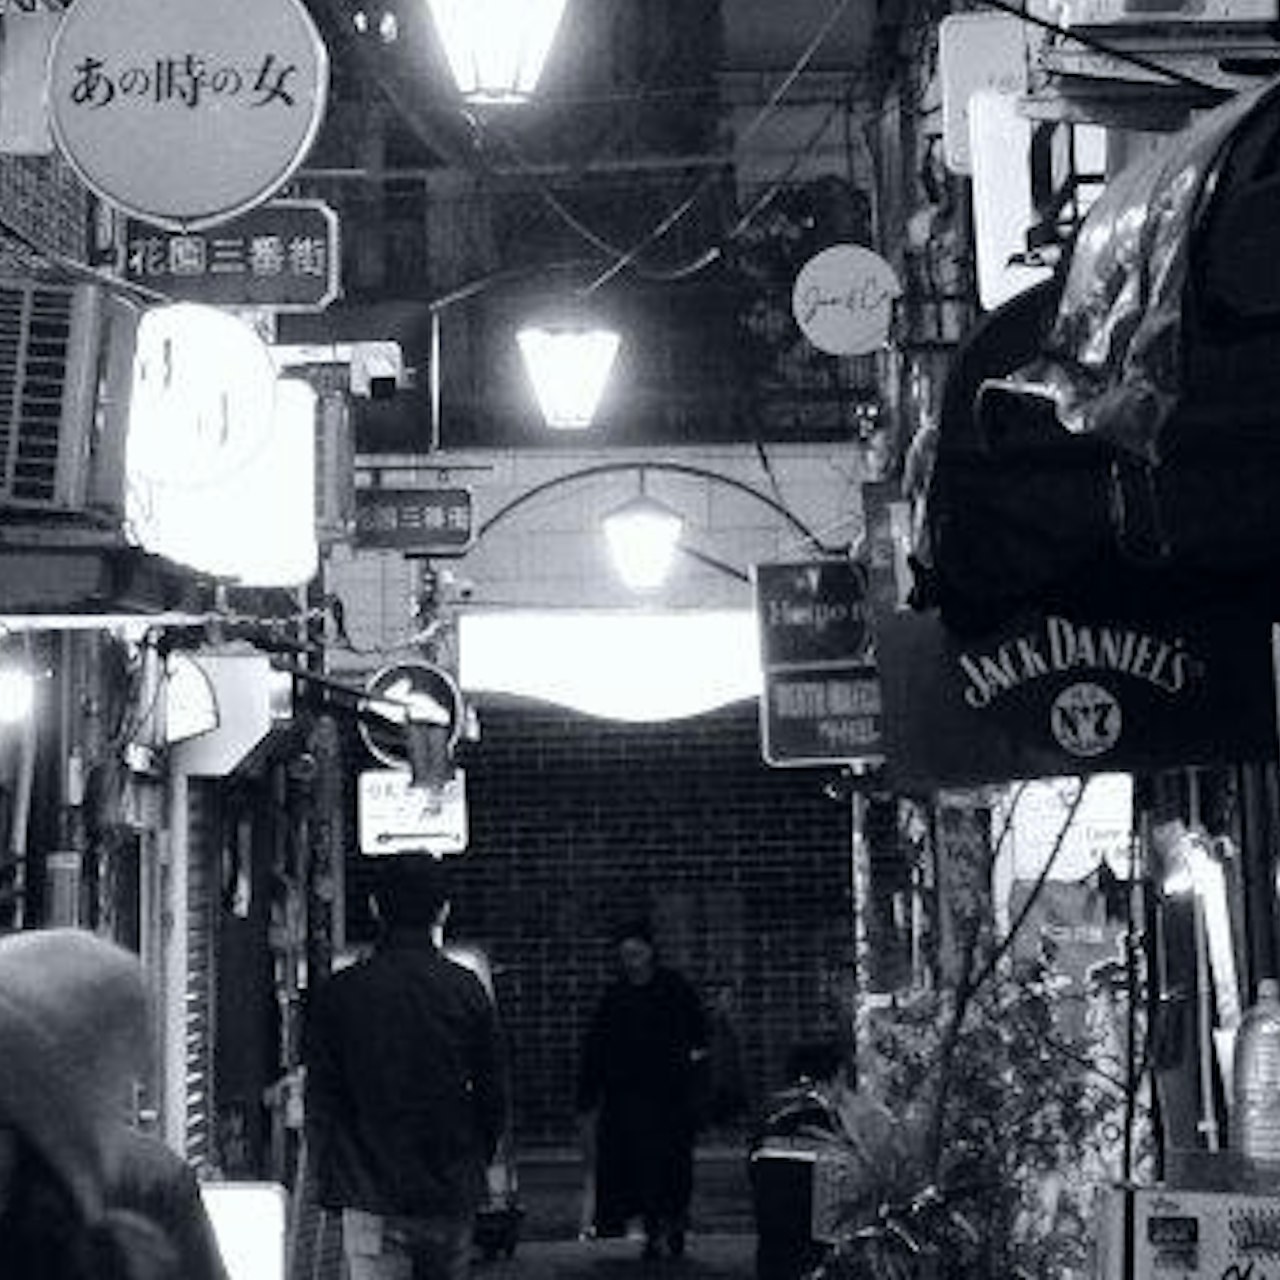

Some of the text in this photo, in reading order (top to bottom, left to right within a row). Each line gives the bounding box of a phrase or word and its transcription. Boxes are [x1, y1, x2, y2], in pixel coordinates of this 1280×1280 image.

[70, 53, 297, 109] あの時の女
[959, 614, 1189, 709] JACK DANIEL'S
